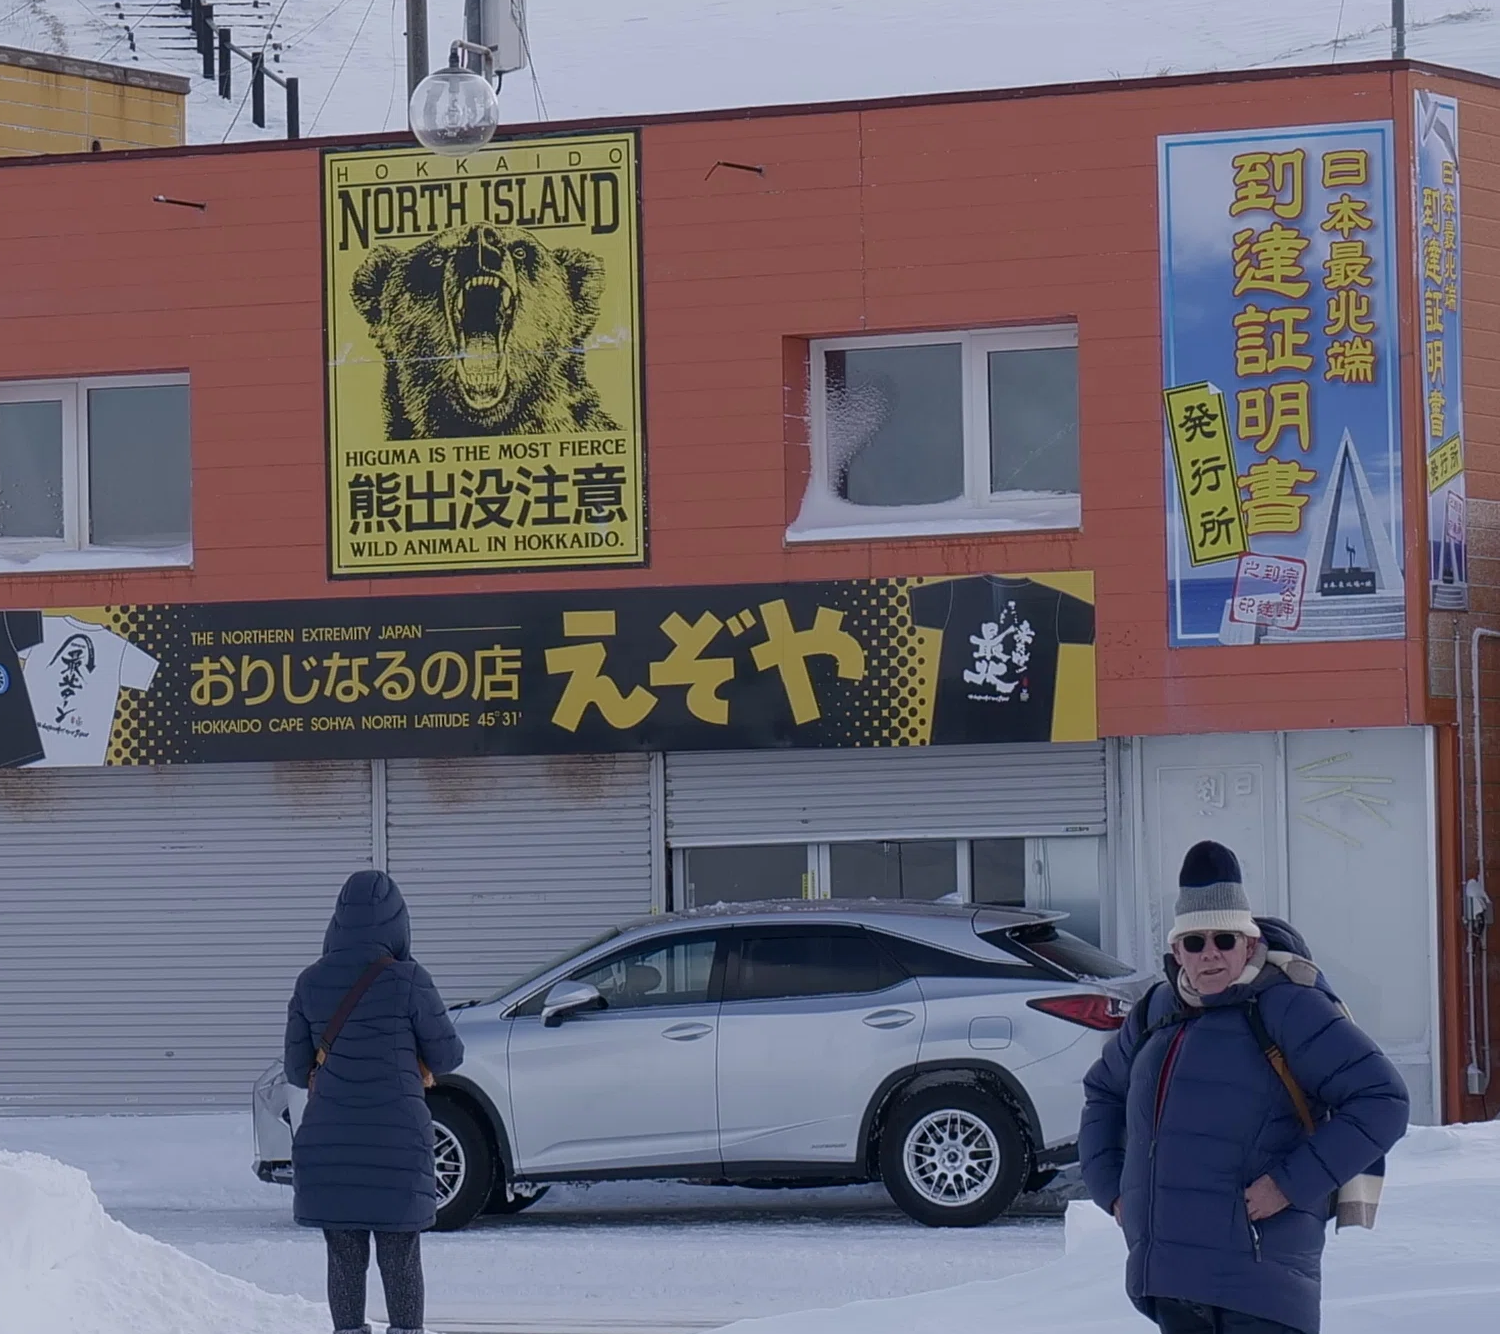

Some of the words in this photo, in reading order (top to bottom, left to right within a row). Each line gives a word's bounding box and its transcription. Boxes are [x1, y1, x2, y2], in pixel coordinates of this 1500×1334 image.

[337, 148, 623, 182] HOKKAIDO
[338, 181, 467, 250] NORTH
[481, 172, 620, 235] ISLAND
[1442, 161, 1458, 312] 日本最北端
[1321, 148, 1376, 384] 日本最北端
[1230, 148, 1317, 536] 到達証明書
[1422, 188, 1446, 437] 到達証明書
[345, 449, 418, 468] HIGUMA
[429, 447, 446, 464] IS
[452, 445, 490, 462] THE
[498, 442, 552, 460] MOST
[559, 439, 627, 457] FIERCE
[1178, 403, 1237, 549] 発行所
[347, 463, 628, 534] 熊出没注意
[350, 540, 398, 558] WILD
[403, 536, 480, 555] ANIMAL
[487, 535, 507, 552] IN
[514, 531, 625, 551] HOKKAIDO.
[191, 632, 214, 646] THE
[221, 629, 295, 645] NORTHERN
[302, 626, 371, 642] EXTREMITY
[378, 625, 422, 640] JAPAN
[544, 599, 864, 733] えぞや
[190, 644, 522, 706] おりじなるの店
[192, 719, 262, 734] HOKKAIDO
[269, 717, 304, 732] CAPE
[310, 716, 354, 731] SOHYA
[362, 715, 407, 729] NORTH
[414, 714, 469, 728] LATITUDE
